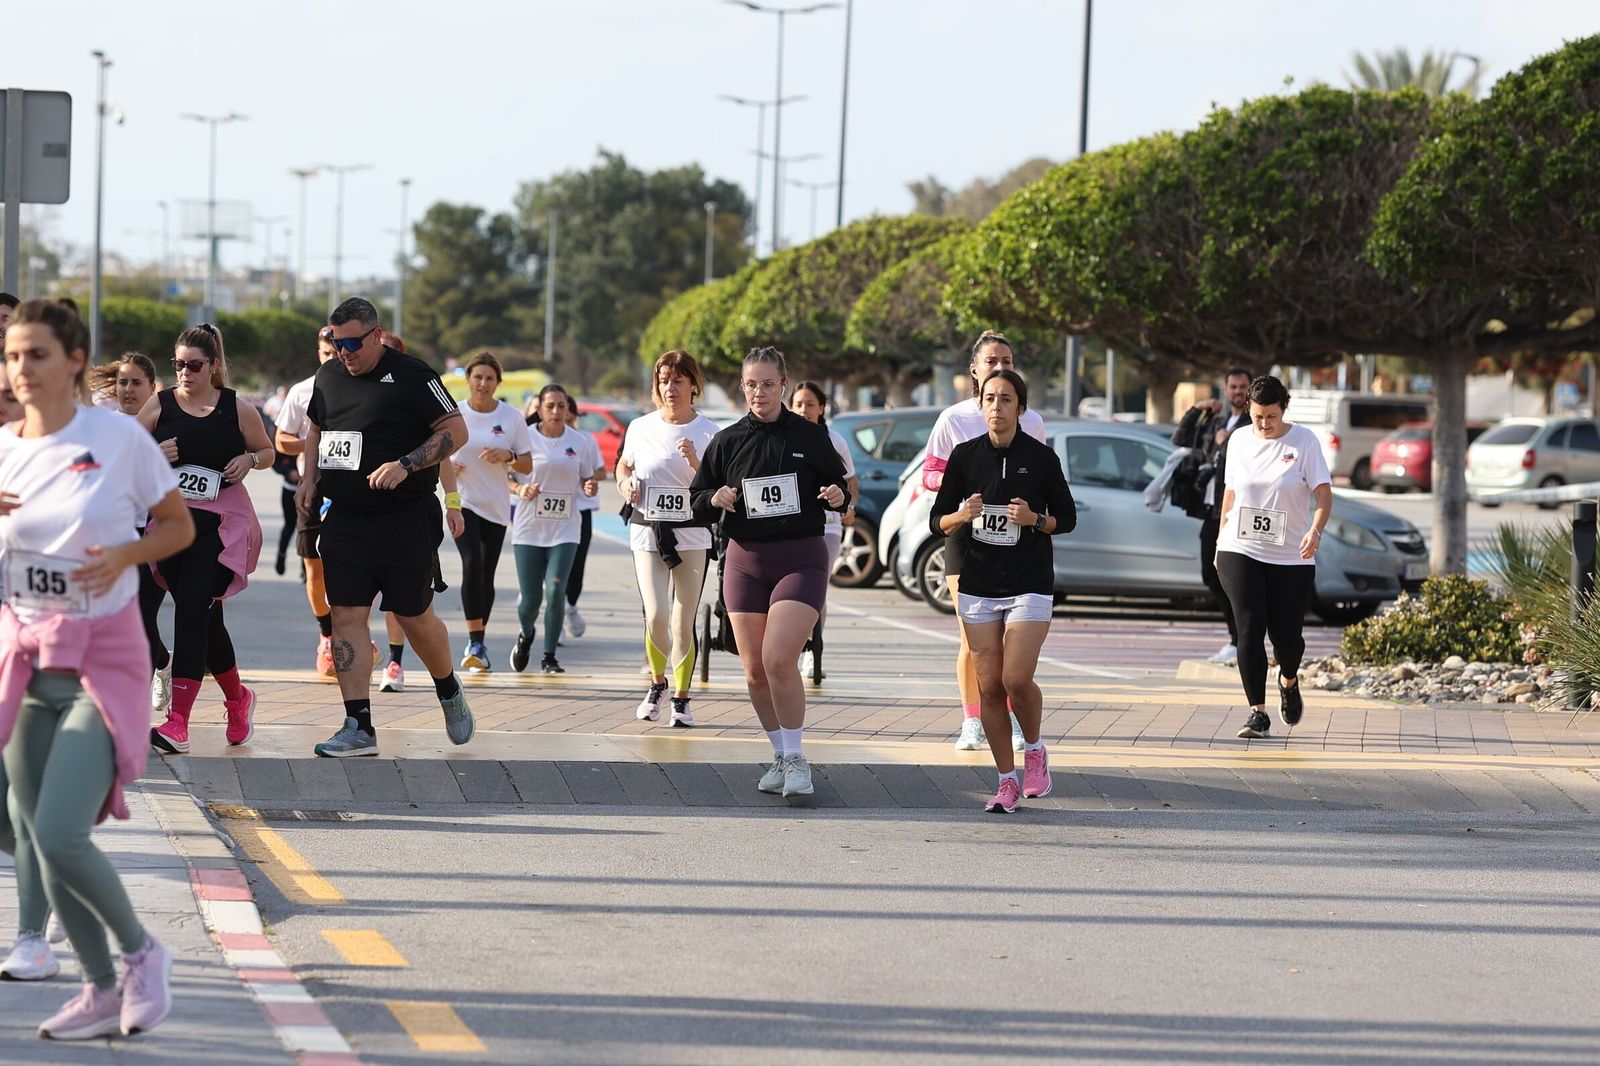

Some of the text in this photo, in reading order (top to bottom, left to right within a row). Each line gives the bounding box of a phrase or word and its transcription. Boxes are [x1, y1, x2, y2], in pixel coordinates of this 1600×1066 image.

[328, 440, 351, 457] 243
[178, 472, 208, 492] 226
[656, 494, 684, 510] 439
[761, 485, 782, 503] 49
[543, 498, 565, 512] 379
[981, 513, 1008, 532] 142
[1253, 515, 1271, 531] 53
[26, 566, 67, 595] 135
